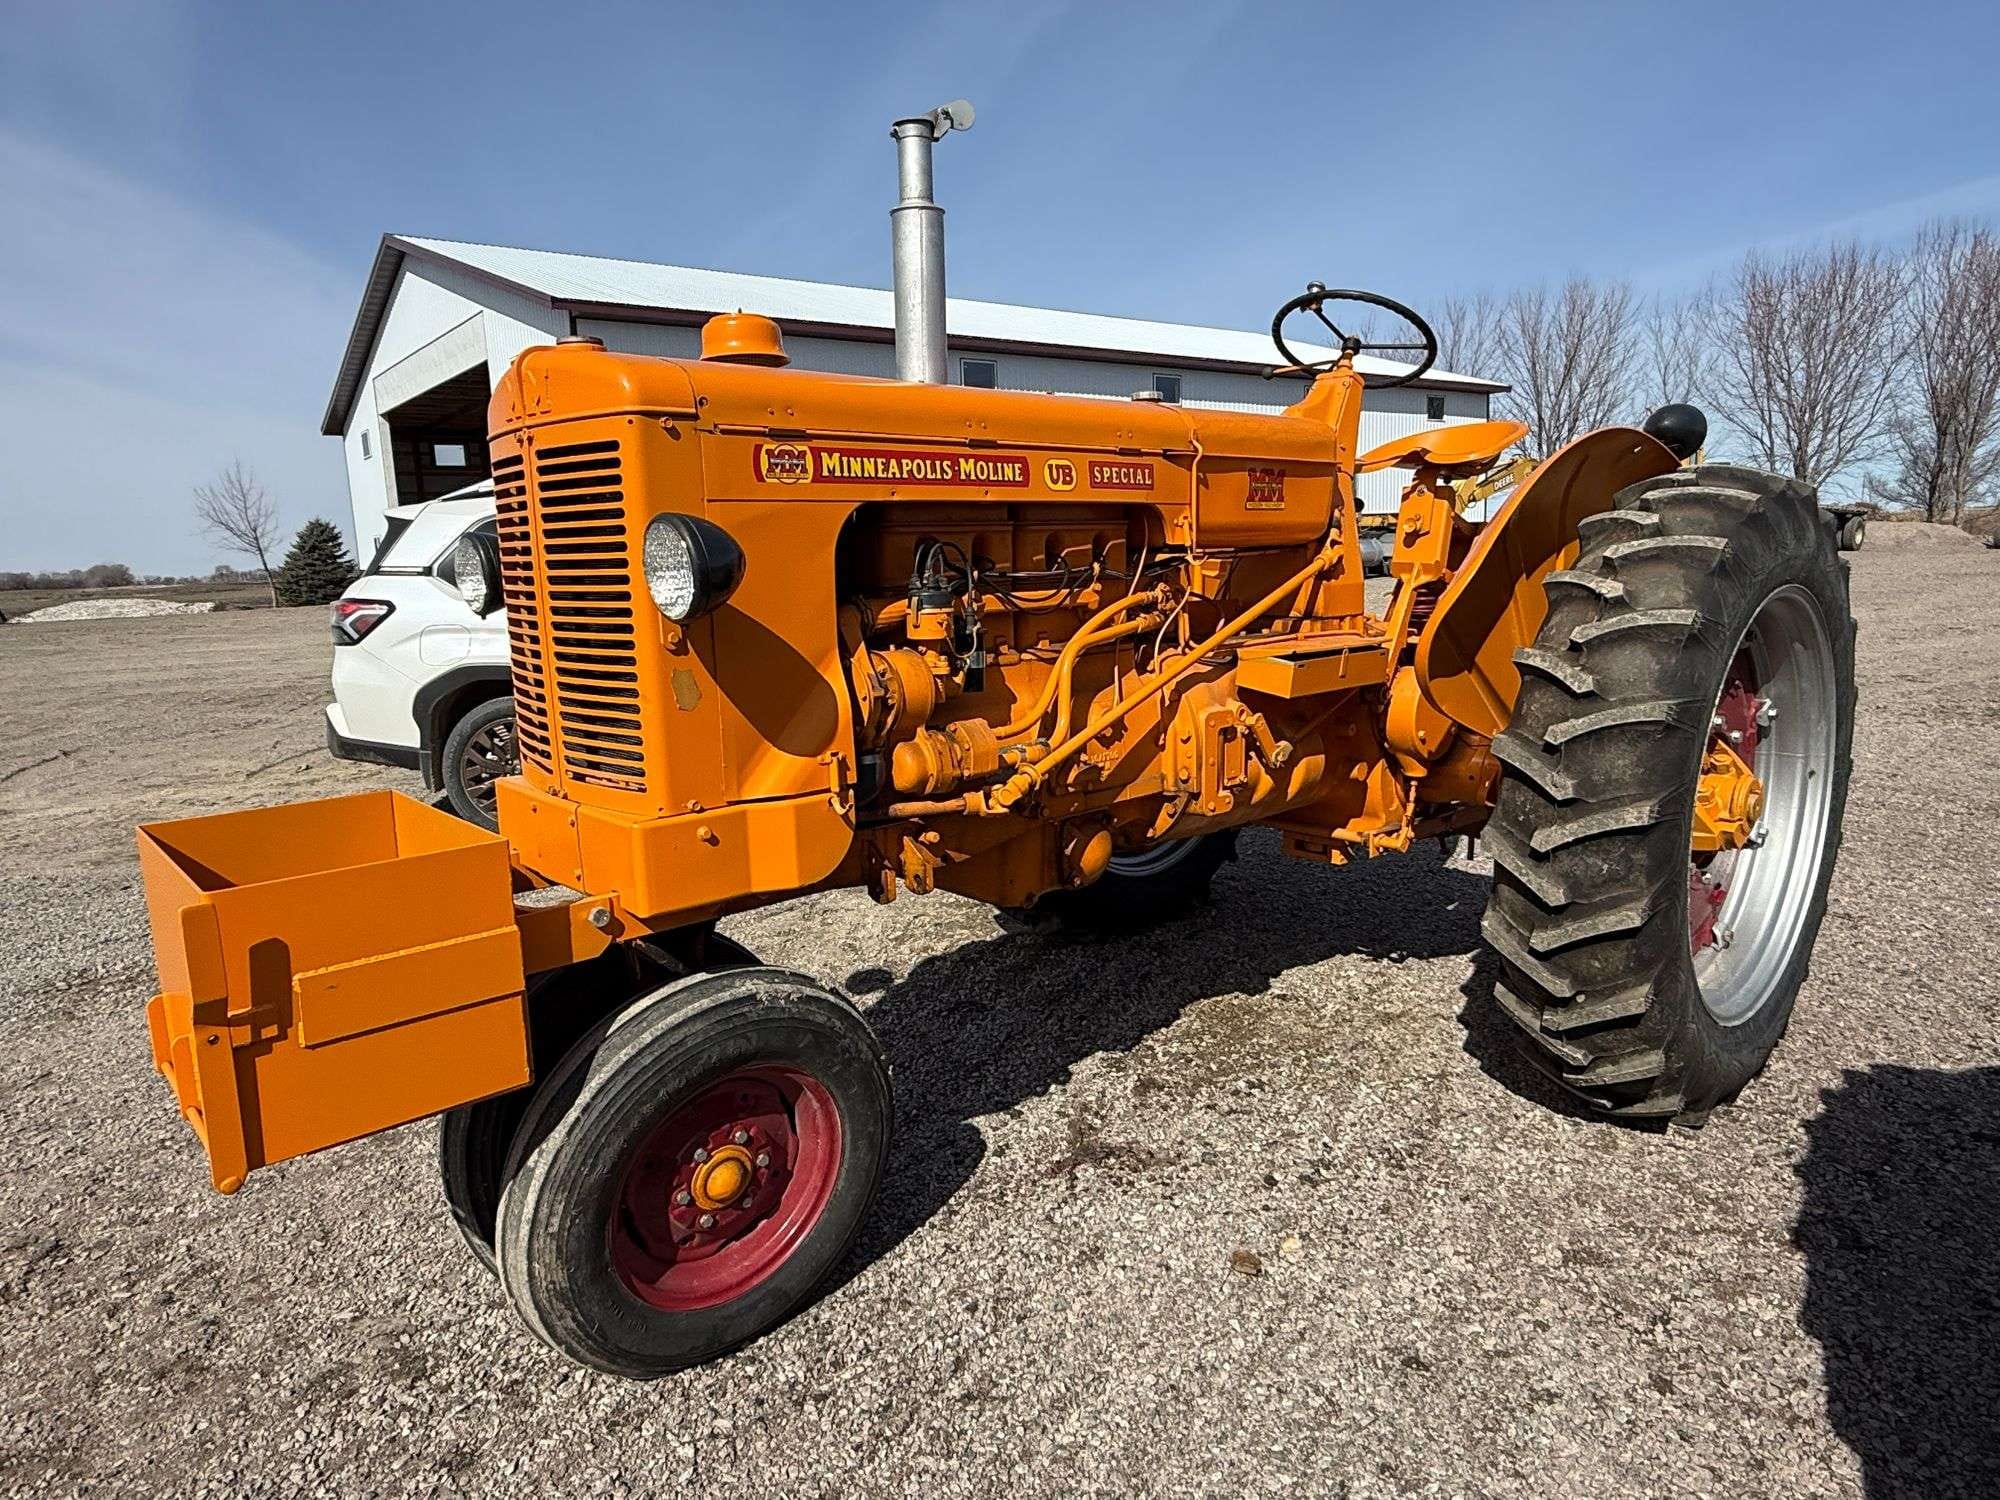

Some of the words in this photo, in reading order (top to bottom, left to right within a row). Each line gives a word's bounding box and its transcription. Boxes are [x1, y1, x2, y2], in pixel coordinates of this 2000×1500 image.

[1047, 463, 1073, 486] UB
[1094, 466, 1152, 485] SPECIAL
[1494, 473, 1514, 491] DEERE
